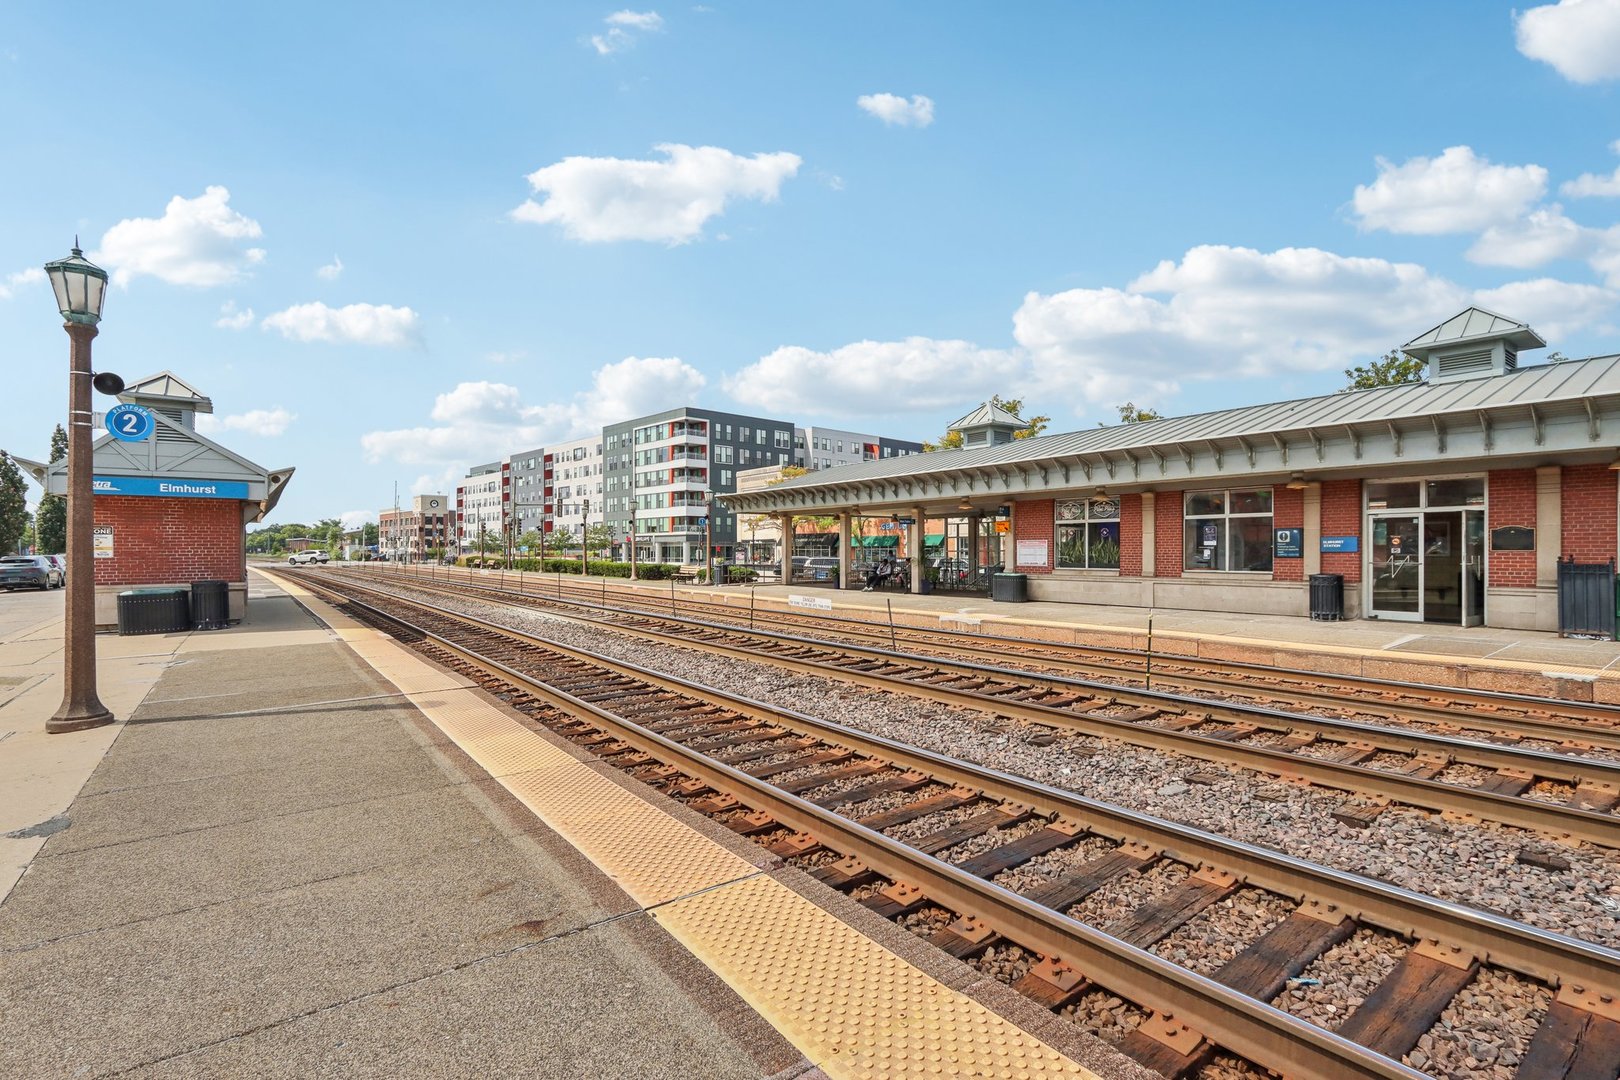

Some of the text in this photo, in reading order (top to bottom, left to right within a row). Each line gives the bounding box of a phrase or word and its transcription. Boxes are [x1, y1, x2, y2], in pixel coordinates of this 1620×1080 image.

[112, 404, 149, 416] PLATFORM
[122, 413, 138, 433] 2
[92, 480, 112, 488] etra
[159, 483, 216, 494] Elmhurst
